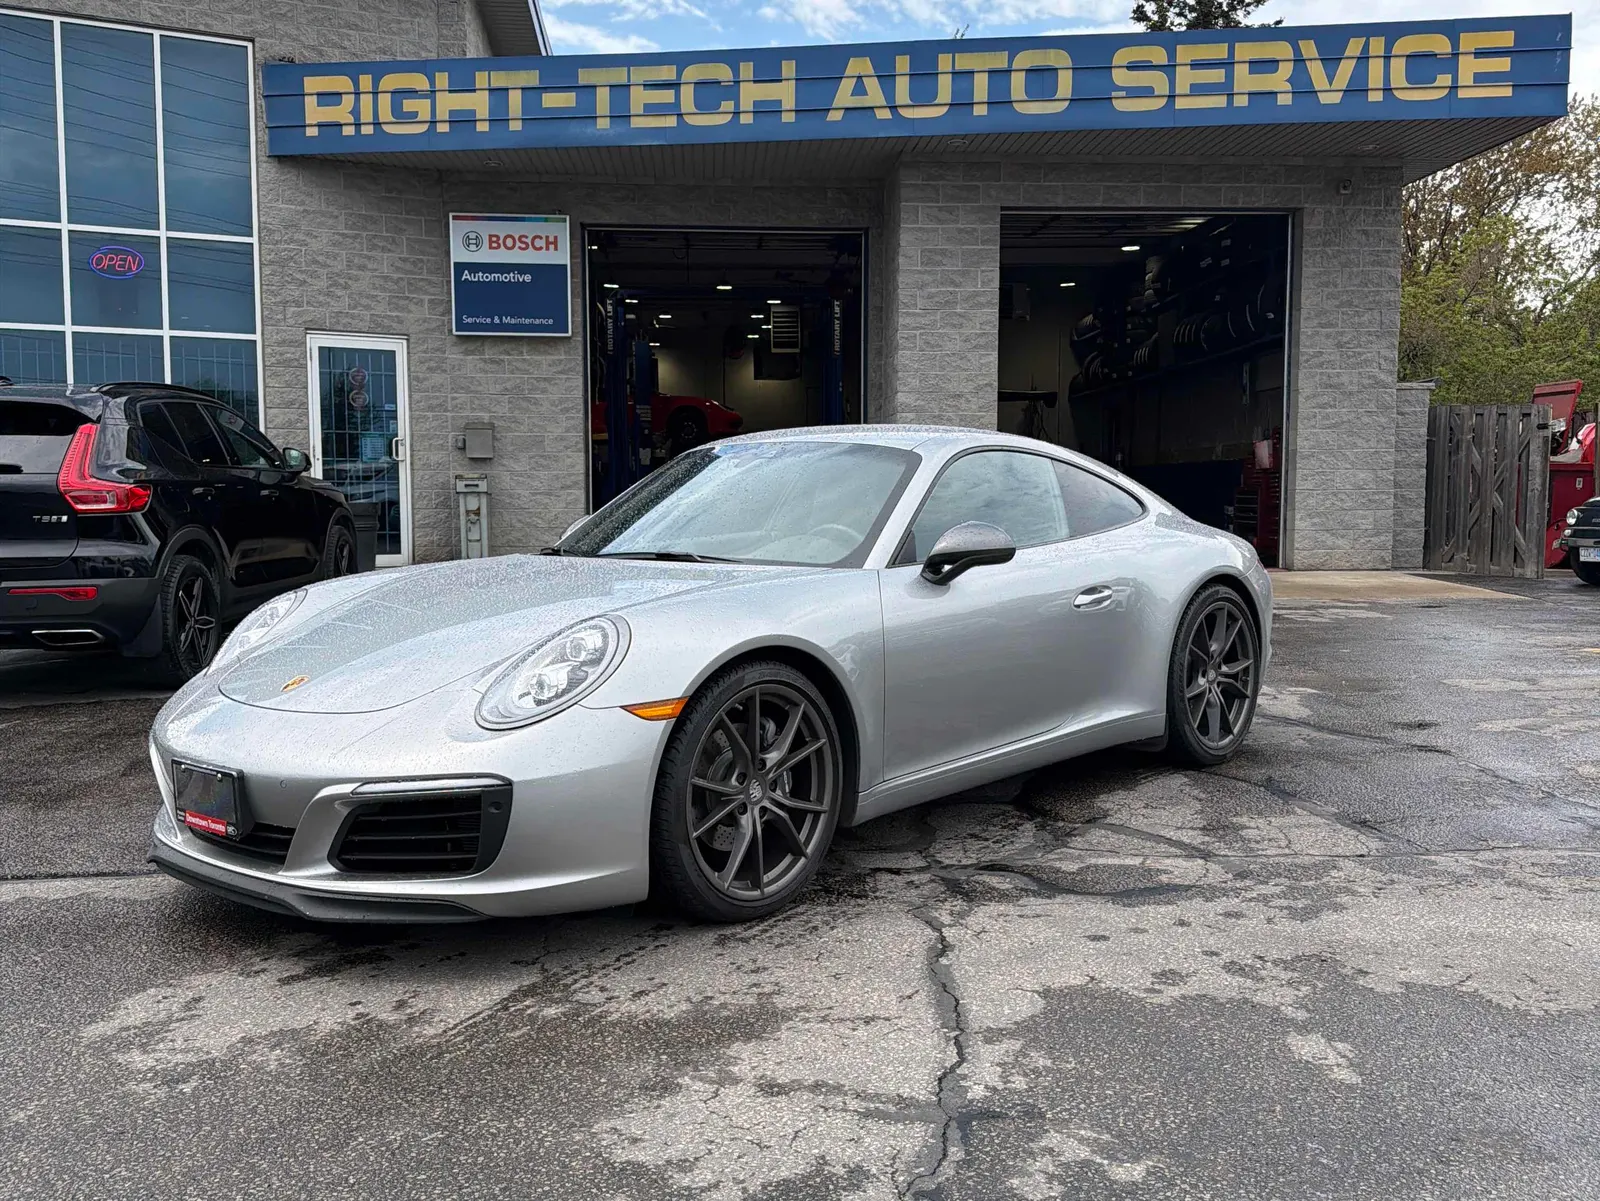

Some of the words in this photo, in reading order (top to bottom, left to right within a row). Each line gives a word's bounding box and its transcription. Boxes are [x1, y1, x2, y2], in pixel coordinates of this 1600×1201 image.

[303, 60, 796, 136] RIGHT-TECH
[826, 49, 1073, 121] AUTO
[1111, 30, 1515, 112] SERVICE
[488, 234, 559, 251] BOSCH
[93, 253, 139, 271] OPEN
[461, 270, 532, 282] Automotive
[462, 315, 491, 324] Service
[493, 316, 500, 324] &
[502, 316, 553, 325] Maintenance
